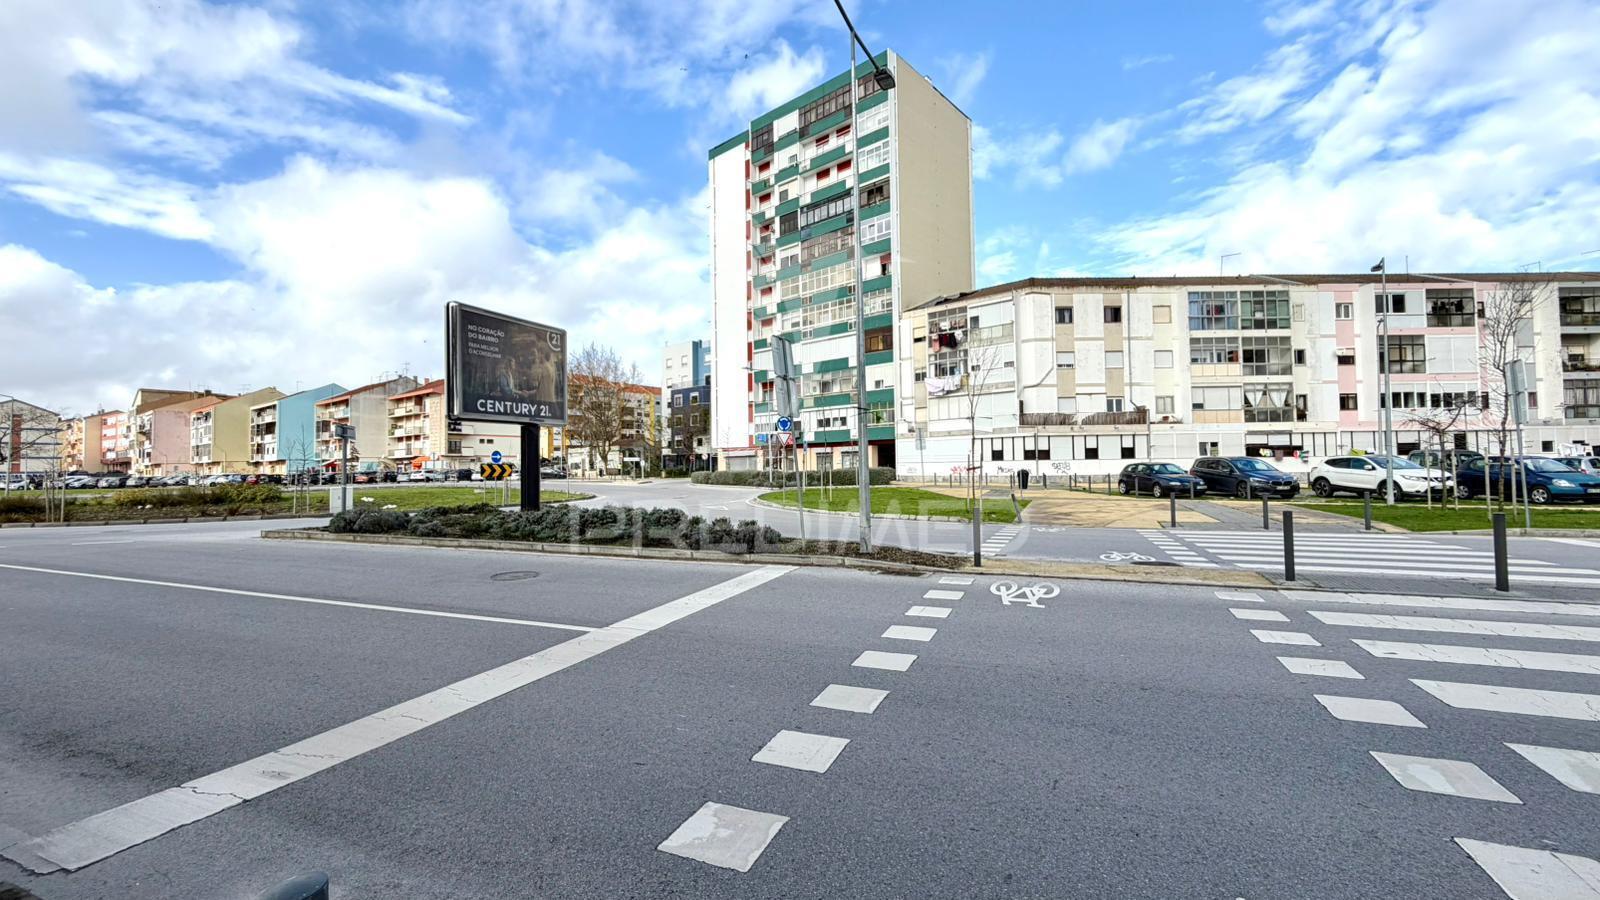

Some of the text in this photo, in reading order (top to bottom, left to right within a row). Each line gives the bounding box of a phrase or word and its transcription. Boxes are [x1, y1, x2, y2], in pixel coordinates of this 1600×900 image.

[478, 334, 498, 343] BAIRRO
[551, 333, 560, 345] 21
[477, 399, 537, 415] CENTURY
